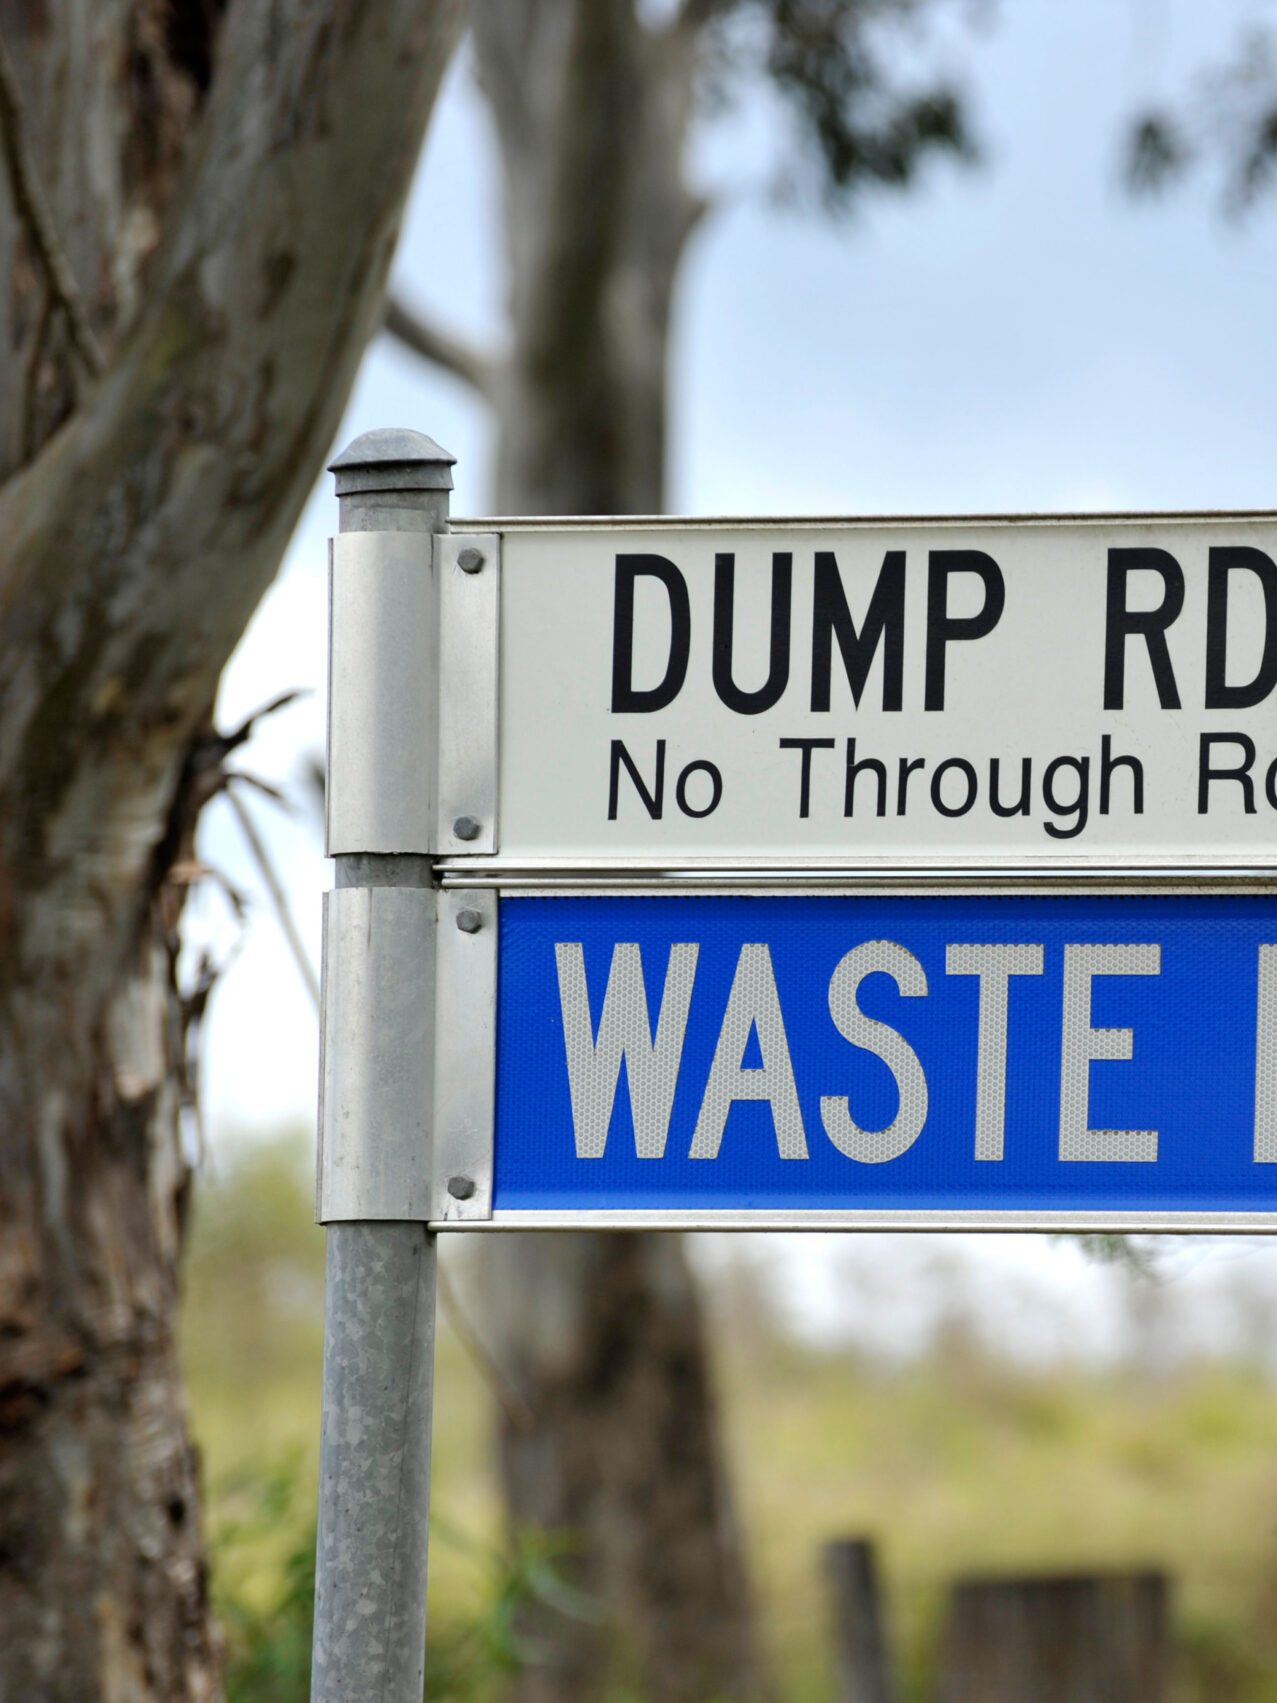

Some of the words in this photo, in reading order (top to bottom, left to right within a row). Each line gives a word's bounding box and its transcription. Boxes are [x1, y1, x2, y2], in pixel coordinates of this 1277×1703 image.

[611, 550, 1006, 715] DUMP
[608, 739, 723, 821] No
[780, 735, 1144, 839] Through
[554, 939, 1162, 1164] WASTE
